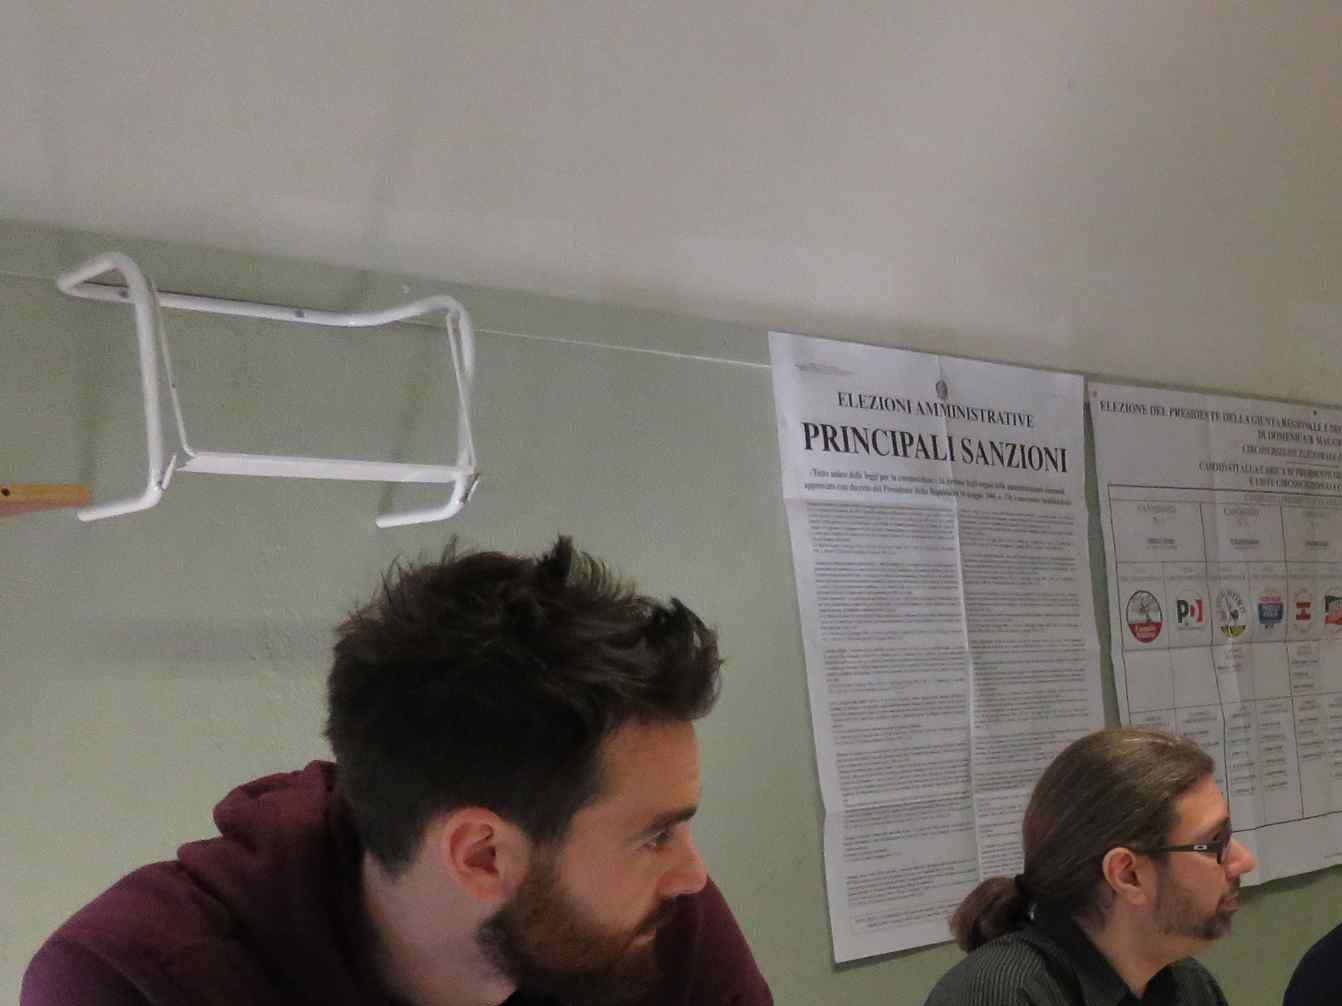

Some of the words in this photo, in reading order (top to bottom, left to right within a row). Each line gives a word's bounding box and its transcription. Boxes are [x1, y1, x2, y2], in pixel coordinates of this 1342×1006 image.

[836, 391, 913, 416] ELEZIONI
[916, 399, 1035, 429] AMMINISTRATIVE
[1099, 399, 1147, 416] ELEZIONE
[802, 421, 957, 464] PRINCIPALI
[960, 438, 1069, 473] SANZIONI
